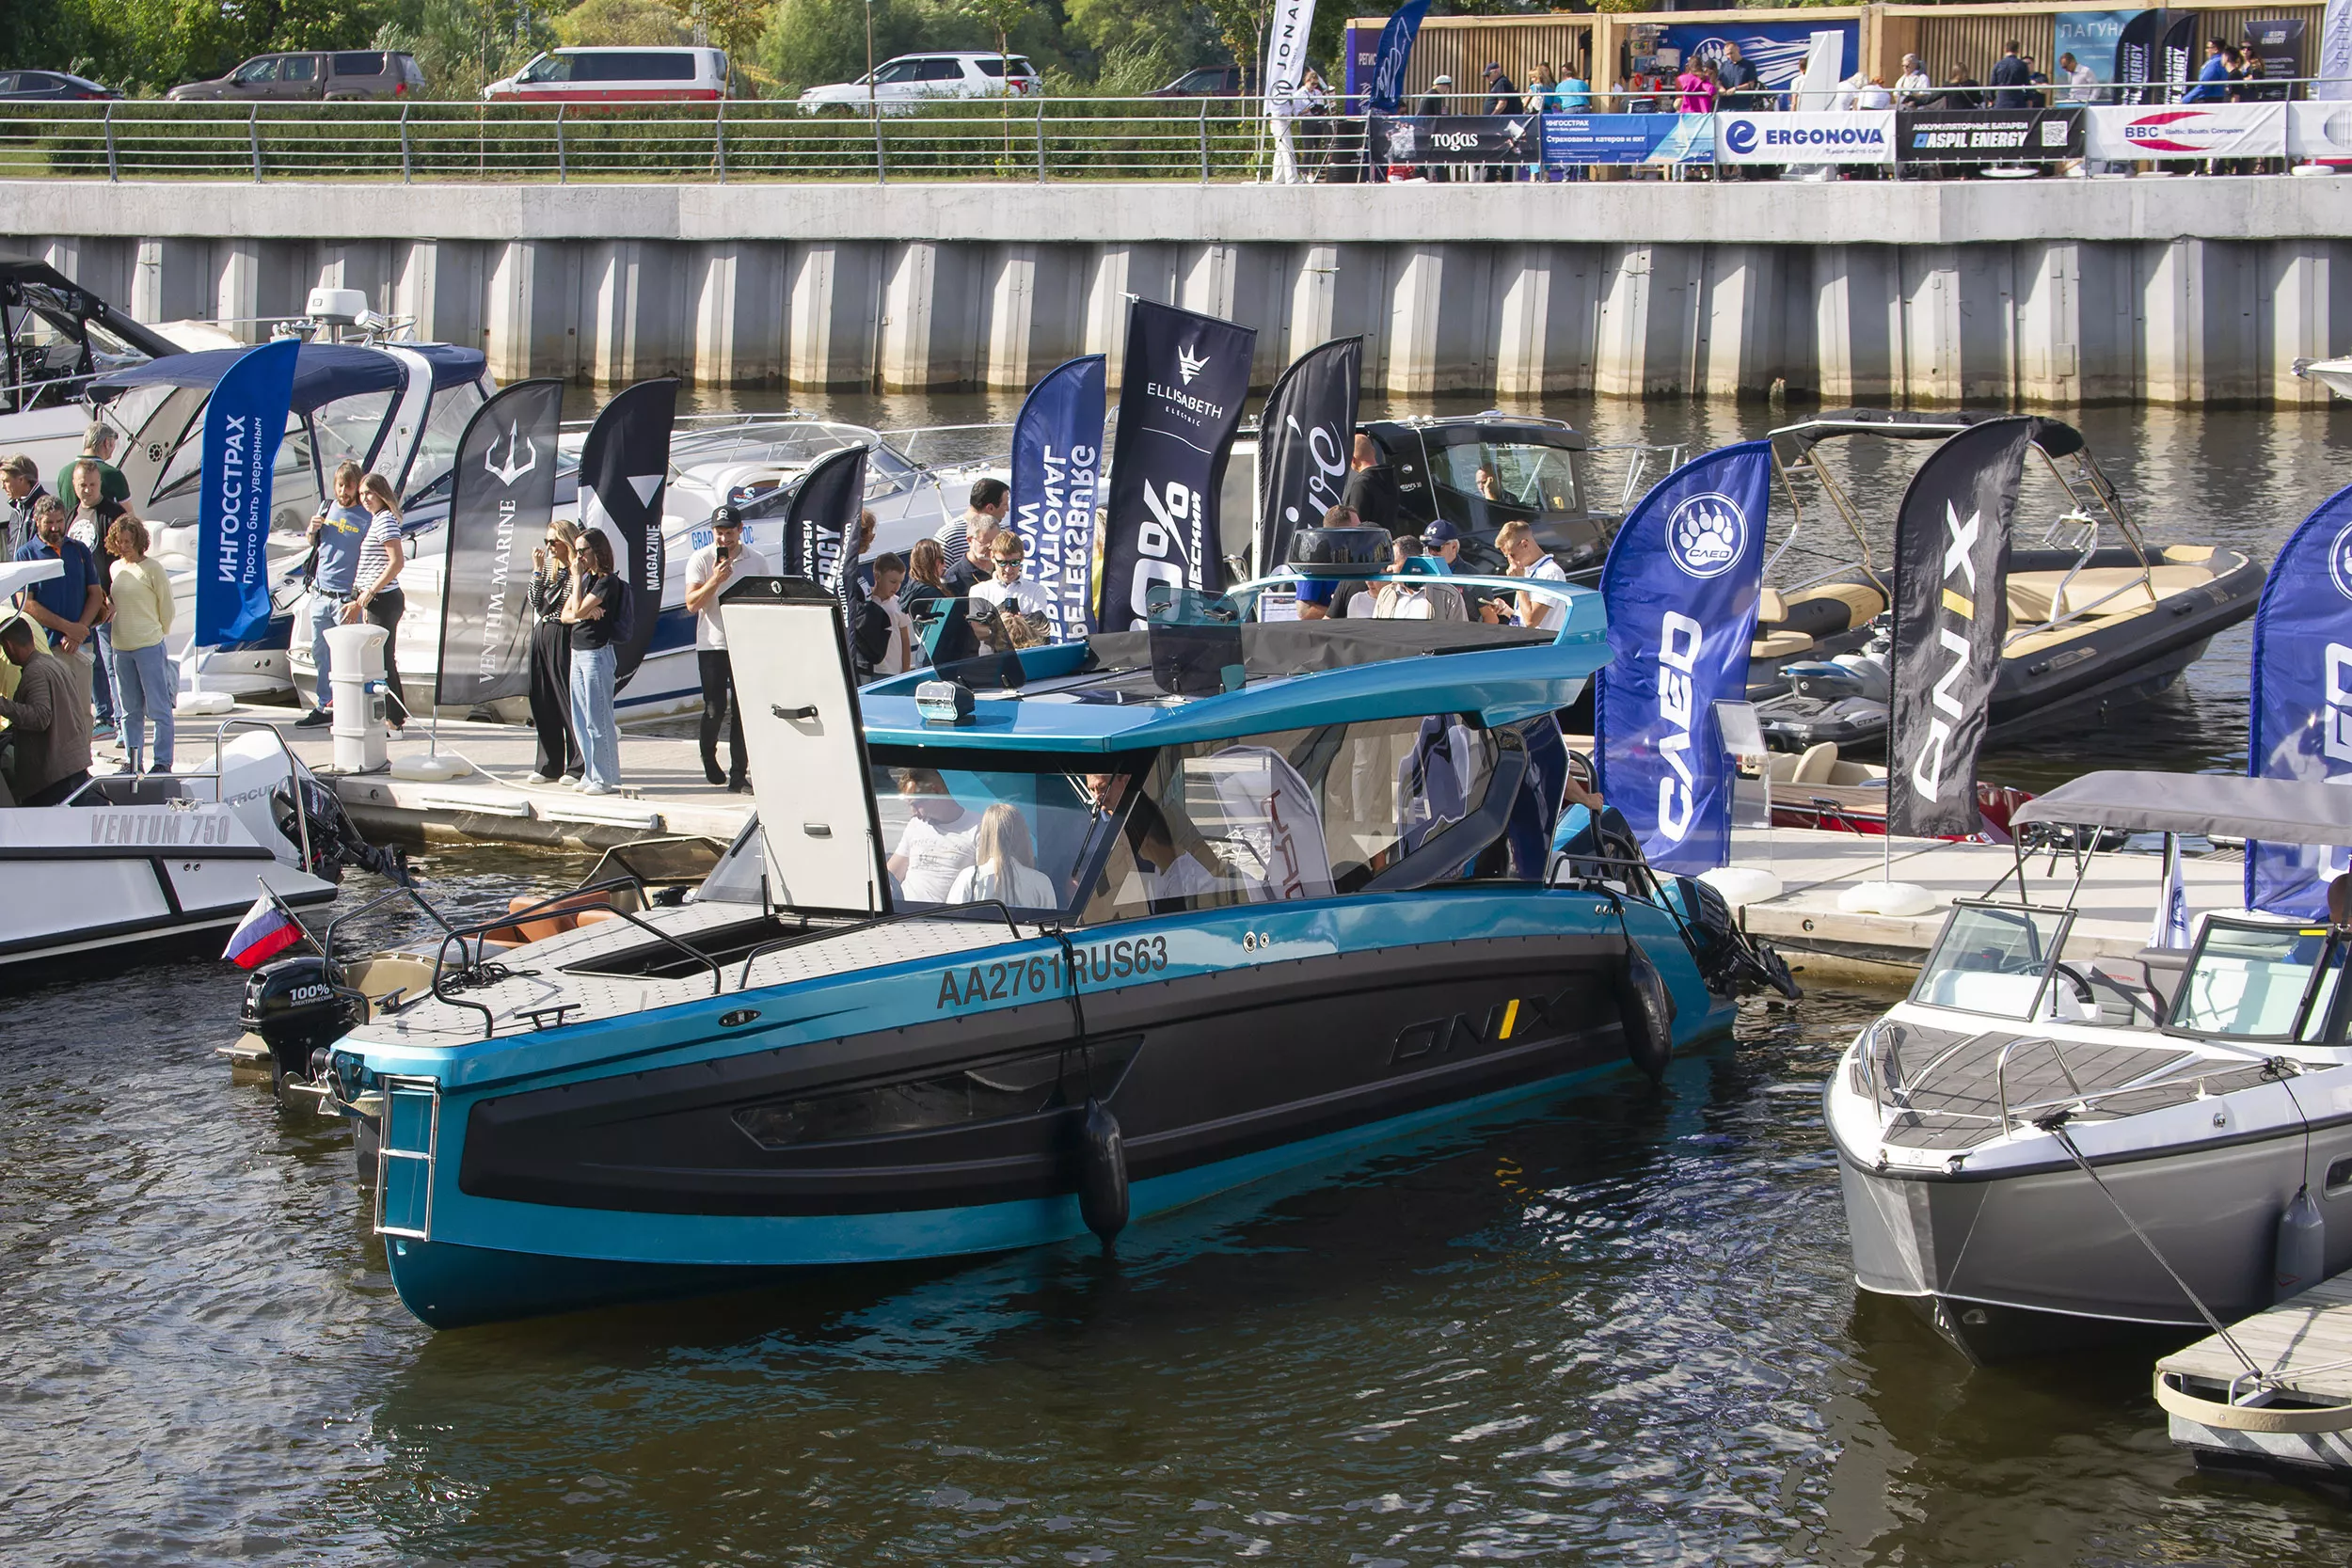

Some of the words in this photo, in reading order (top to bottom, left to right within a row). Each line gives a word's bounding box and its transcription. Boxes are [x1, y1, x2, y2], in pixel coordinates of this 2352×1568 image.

[1277, 0, 1300, 71] JONA
[1359, 53, 1377, 66] РЕГИС
[2130, 44, 2144, 90] NERGY
[1546, 135, 1594, 144] Страхование
[1766, 128, 1884, 145] ERGONOVA
[1926, 133, 1968, 148] ASPIL
[1970, 132, 2028, 148] ENERGY
[2124, 127, 2159, 137] BBC
[1147, 382, 1223, 420] ELLISABETH
[1165, 405, 1201, 427] ELECTRIC
[250, 417, 263, 494] уверенным
[219, 414, 246, 583] ИНГОССТРАХ
[246, 498, 260, 531] быть
[243, 532, 258, 584] Просто
[491, 499, 516, 588] MARINE
[645, 524, 660, 592] MAGAZINE
[817, 524, 841, 594] ERGY
[479, 594, 506, 684] VENTUM
[1912, 499, 1980, 803] ONIX
[224, 784, 276, 808] MERCU
[91, 814, 182, 845] VENTUM
[188, 815, 230, 845] 750
[289, 983, 330, 1002] 100%
[937, 952, 1060, 1009] AA2761
[1069, 935, 1168, 988] RUS63
[1387, 988, 1572, 1067] ONIX
